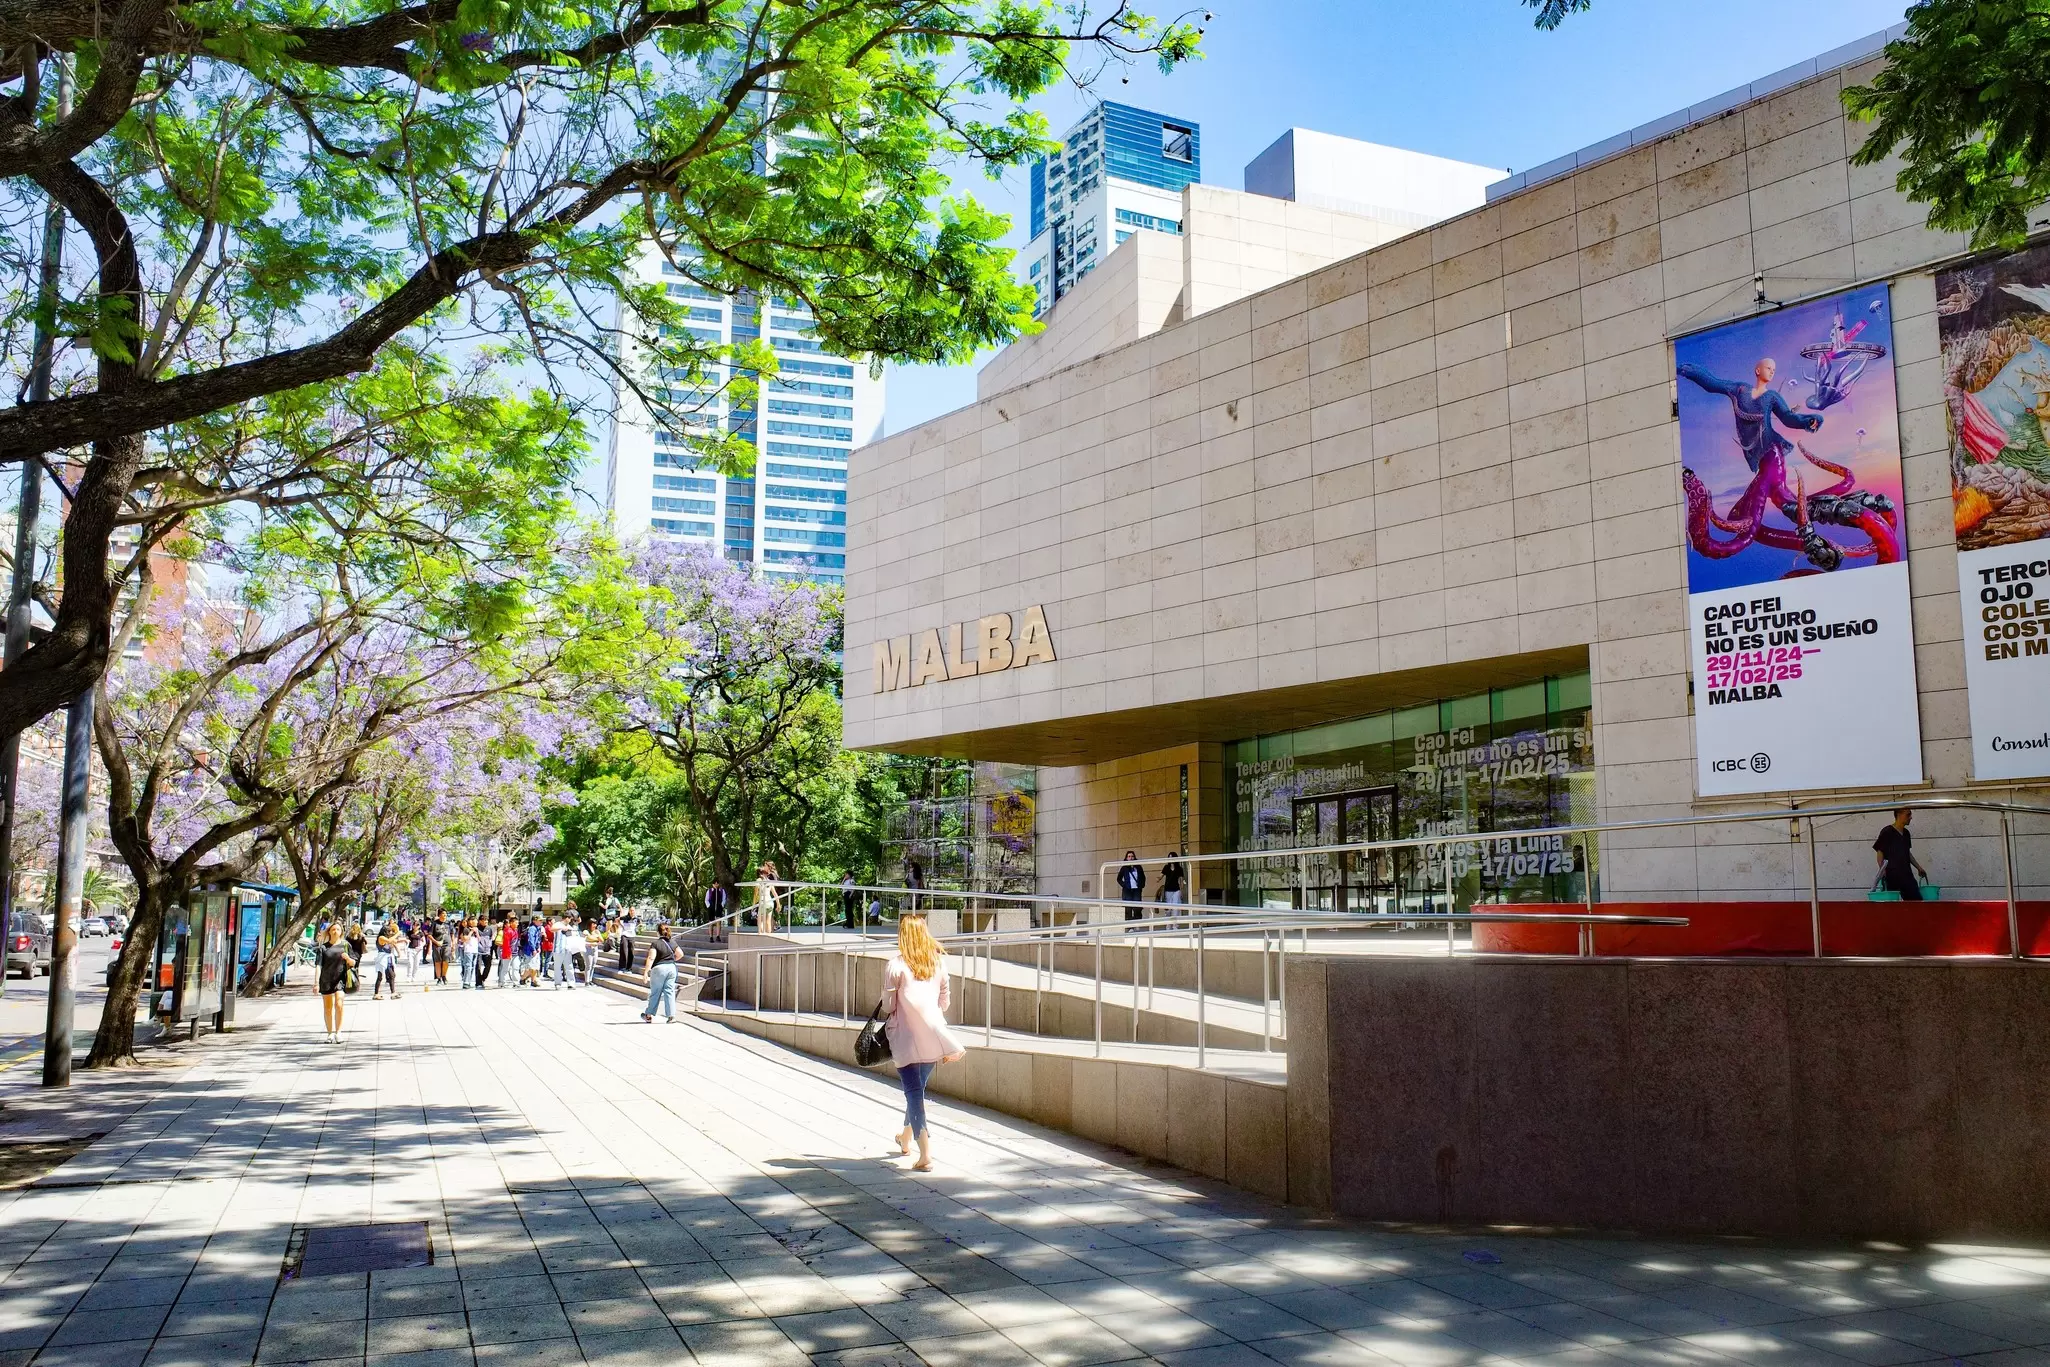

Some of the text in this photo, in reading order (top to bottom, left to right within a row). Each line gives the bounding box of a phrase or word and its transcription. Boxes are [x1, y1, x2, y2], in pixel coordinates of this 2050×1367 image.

[1978, 560, 2050, 585] TERC
[1981, 582, 2033, 604] OJO
[1704, 597, 1781, 621] CAO FEI
[1982, 599, 2050, 622] COLE
[1705, 609, 1816, 638] EL FUTURO
[1984, 618, 2050, 641] COST
[1706, 619, 1878, 654] NO ES UN SUEÑO
[874, 605, 1056, 694] MALBA
[1985, 642, 2019, 661] EN
[1707, 664, 1802, 688] 17/02/25
[1708, 684, 1782, 705] MALBA
[1415, 725, 1474, 751] Cao Fei
[1992, 732, 2050, 752] Consul
[1415, 753, 1428, 770] El
[1433, 746, 1486, 768] futuro
[1490, 743, 1512, 761] no
[1517, 739, 1540, 755] es
[1544, 735, 1568, 752] un
[1236, 754, 1294, 776] Tercer ojo
[1296, 760, 1364, 786] Costantini
[1712, 759, 1746, 772] ICBC
[1236, 800, 1250, 814] en
[1416, 819, 1466, 836] Tunga
[1237, 836, 1264, 851] John
[1480, 840, 1491, 858] y
[1496, 838, 1511, 853] la
[1516, 835, 1564, 853] Luna
[1237, 857, 1247, 870] El
[1267, 855, 1284, 868] de
[1285, 854, 1295, 867] la
